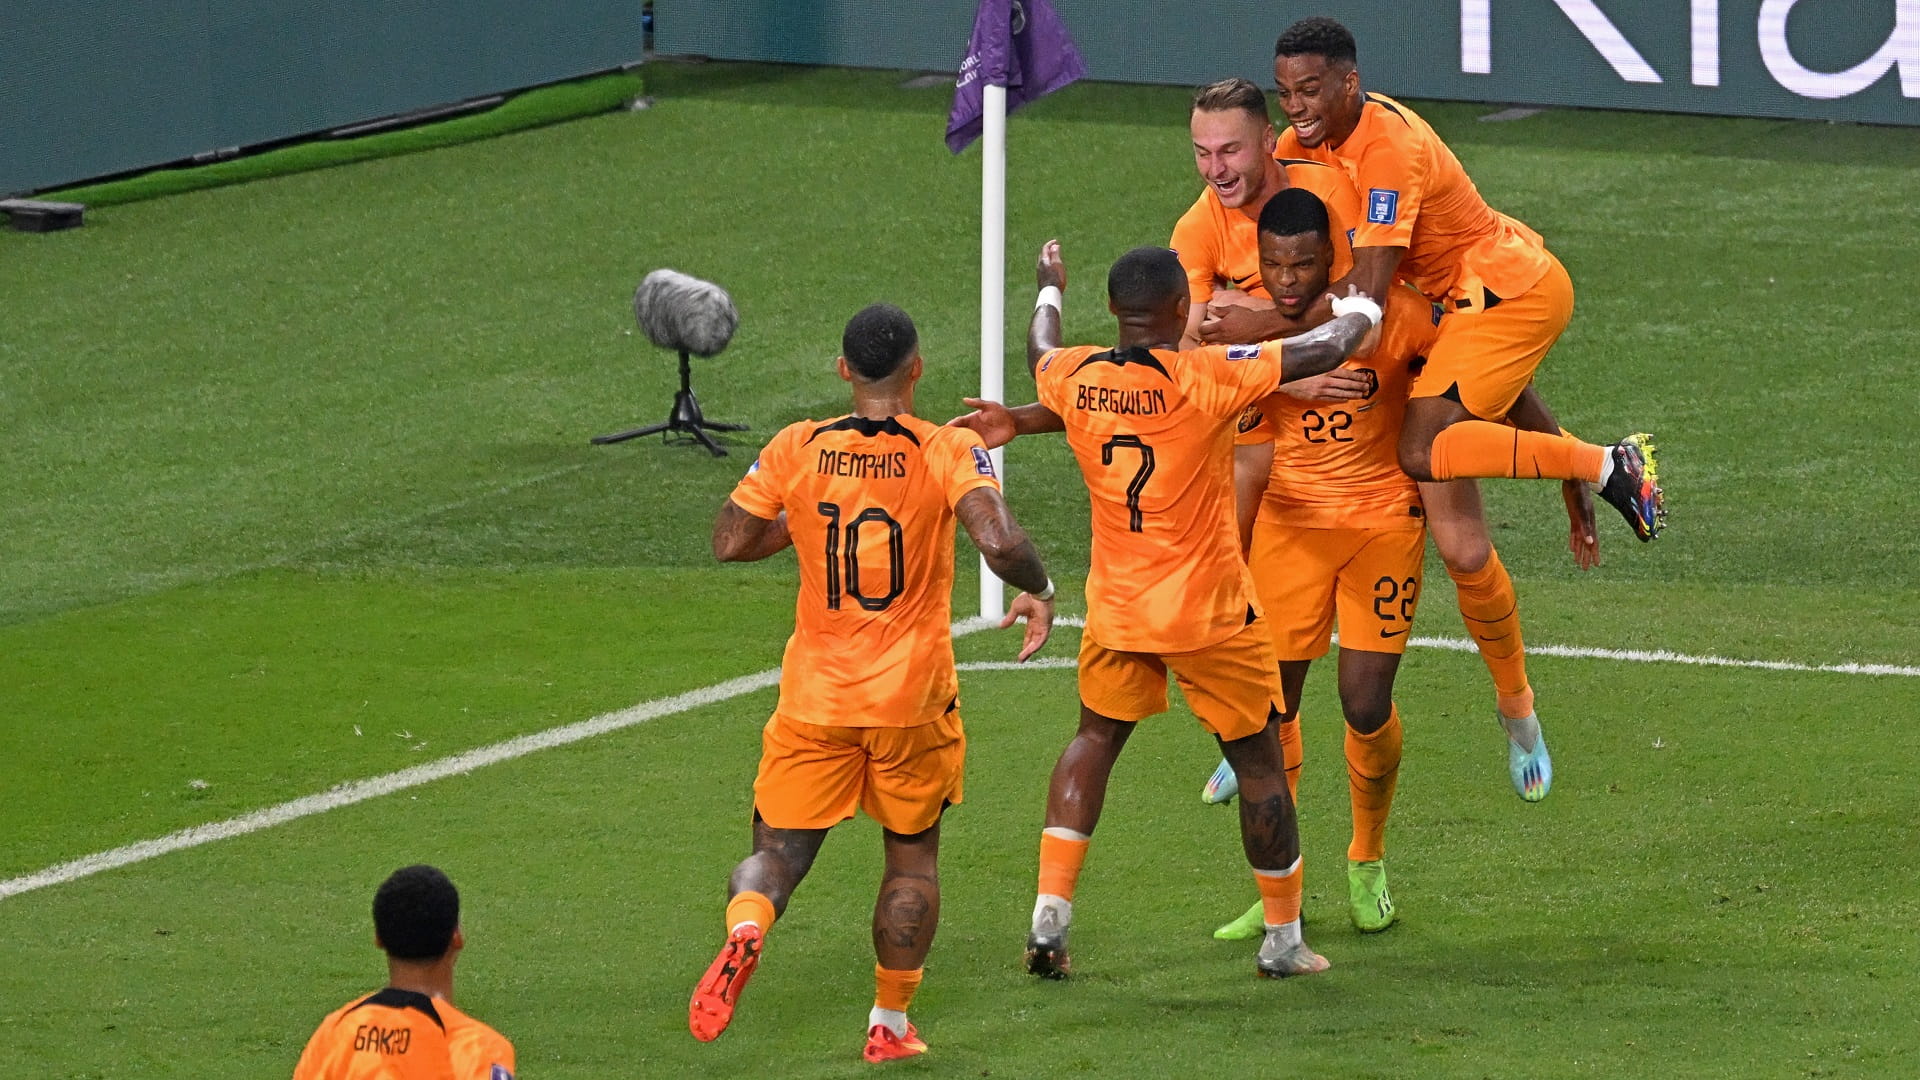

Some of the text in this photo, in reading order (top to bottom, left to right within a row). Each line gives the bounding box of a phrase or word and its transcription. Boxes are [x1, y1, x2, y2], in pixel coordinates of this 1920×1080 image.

[959, 51, 981, 74] ORL
[1077, 384, 1167, 415] BERGWIJN
[1302, 409, 1354, 443] 22
[1102, 434, 1155, 533] 7
[817, 501, 905, 611] 10
[1373, 576, 1417, 622] 22
